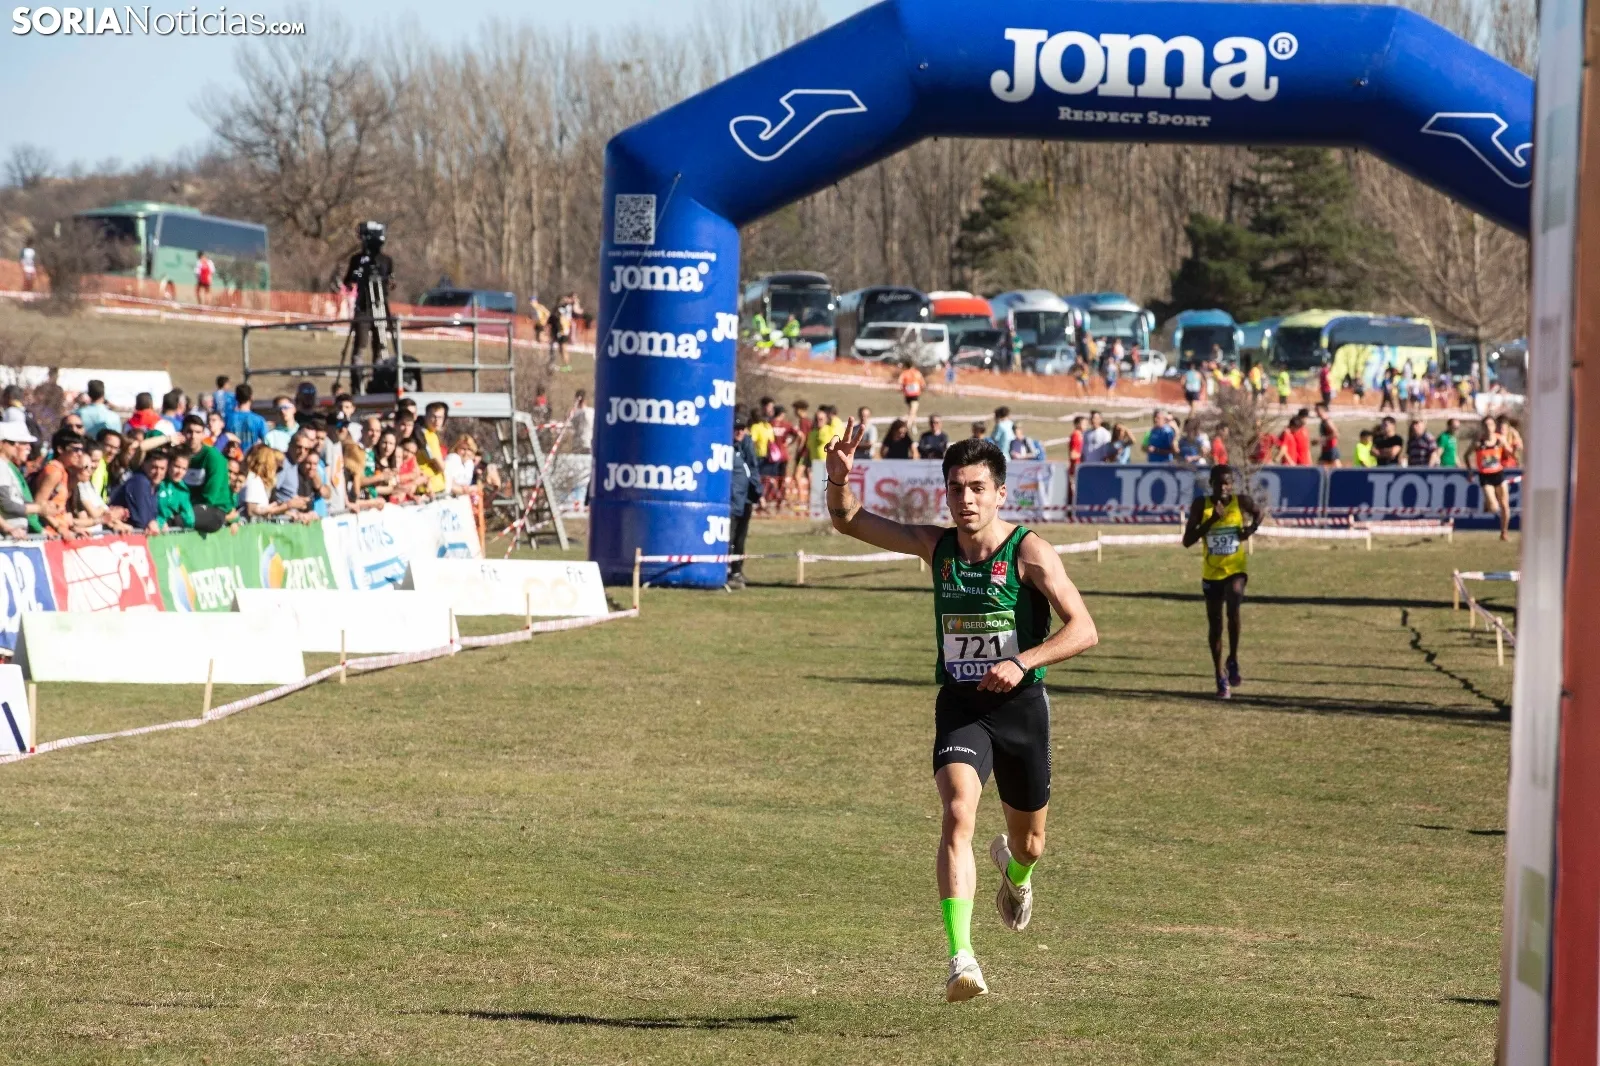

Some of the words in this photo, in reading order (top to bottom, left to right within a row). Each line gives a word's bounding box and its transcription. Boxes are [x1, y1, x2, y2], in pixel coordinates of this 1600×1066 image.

[1058, 106, 1143, 124] RESPECT
[1147, 111, 1211, 127] SPORT
[1212, 535, 1235, 548] 597
[566, 565, 586, 585] fit
[962, 618, 1011, 630] IBERDROLA
[954, 635, 1003, 660] 721
[952, 661, 996, 680] Jom
